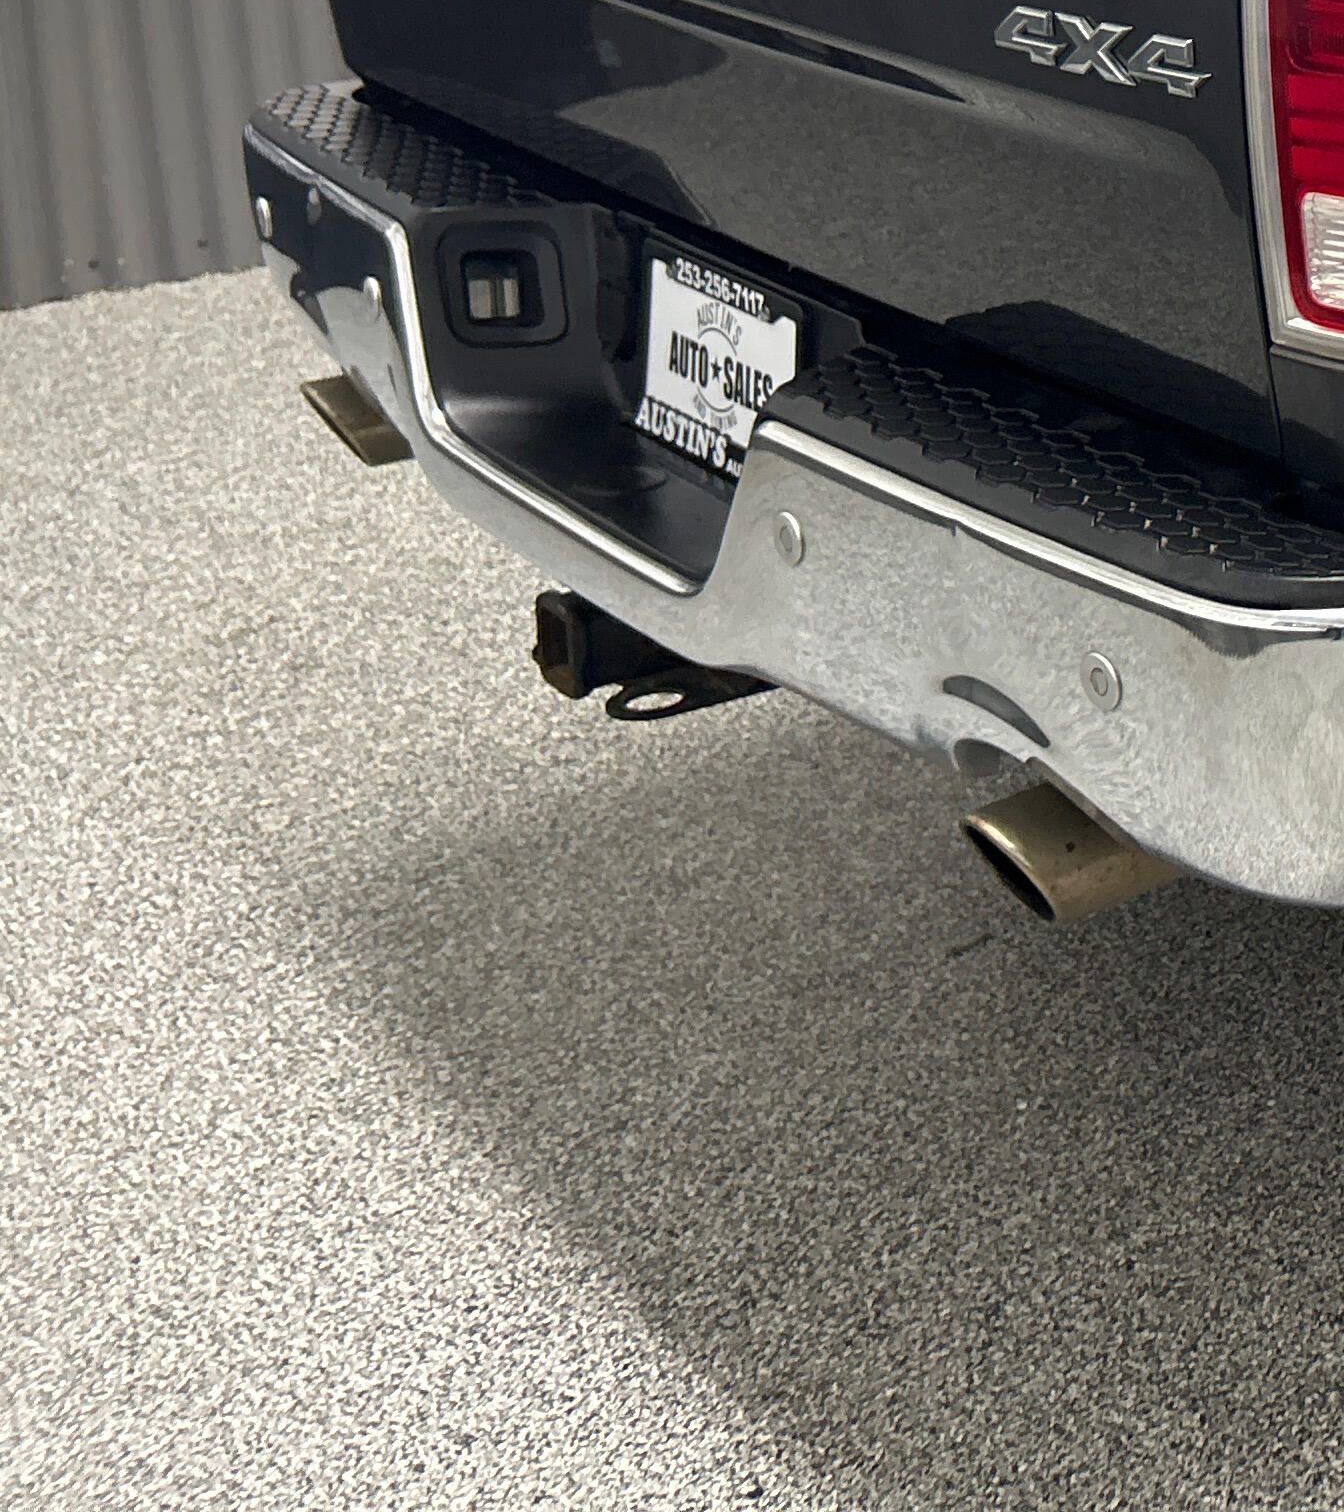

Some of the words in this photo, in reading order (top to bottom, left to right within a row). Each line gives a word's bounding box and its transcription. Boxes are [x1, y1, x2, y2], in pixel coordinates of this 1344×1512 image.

[675, 257, 766, 317] 253-256-7117
[669, 330, 709, 388] AUTO
[723, 355, 774, 410] SALES
[635, 396, 728, 466] AUSTIN'S
[725, 462, 744, 478] AU
